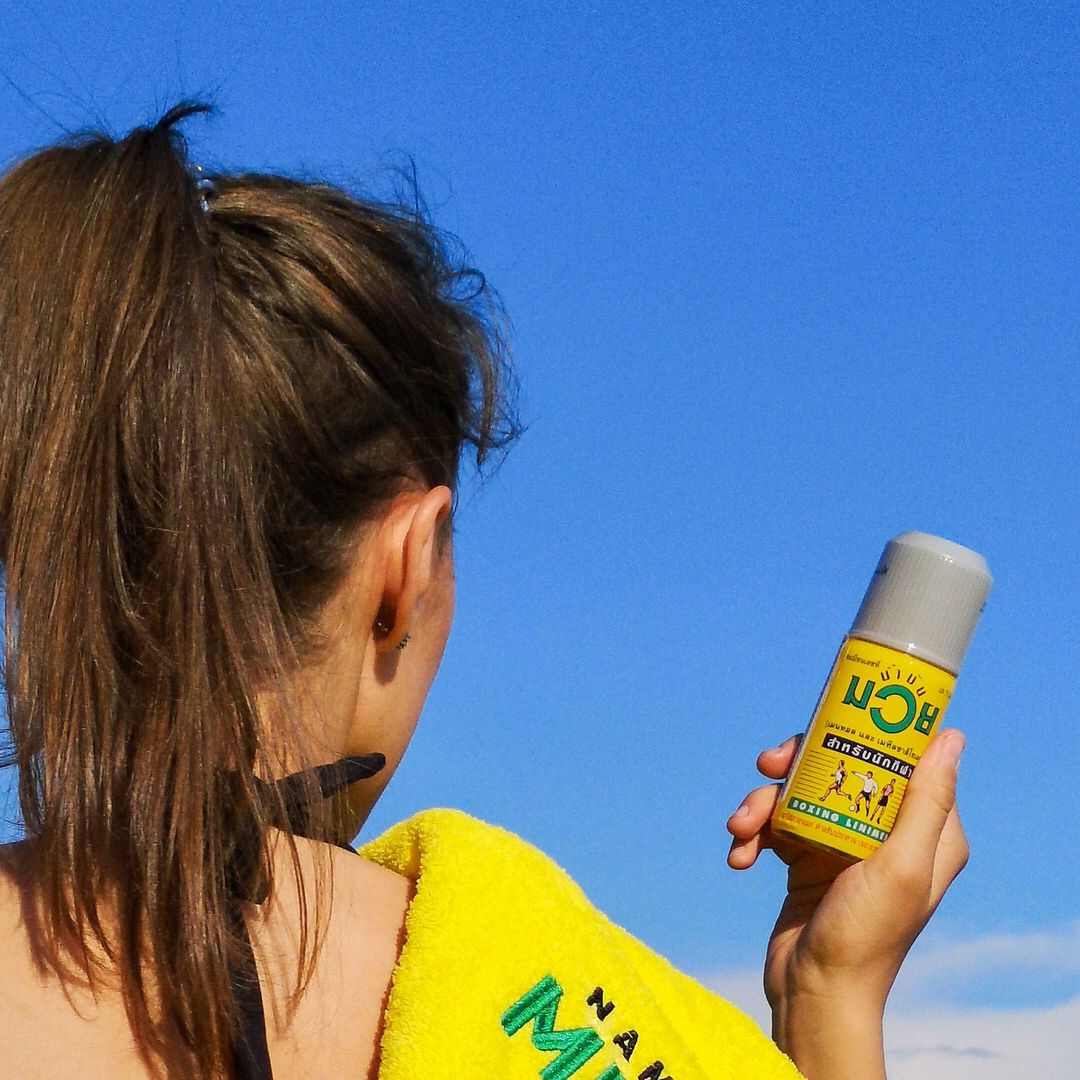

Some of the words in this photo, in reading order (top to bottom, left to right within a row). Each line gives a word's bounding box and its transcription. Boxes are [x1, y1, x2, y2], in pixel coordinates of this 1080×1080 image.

[841, 674, 940, 736] มวย
[826, 736, 913, 779] สำหรับนักกีฬา
[792, 799, 840, 823] BOXING
[845, 818, 889, 842] LINIME
